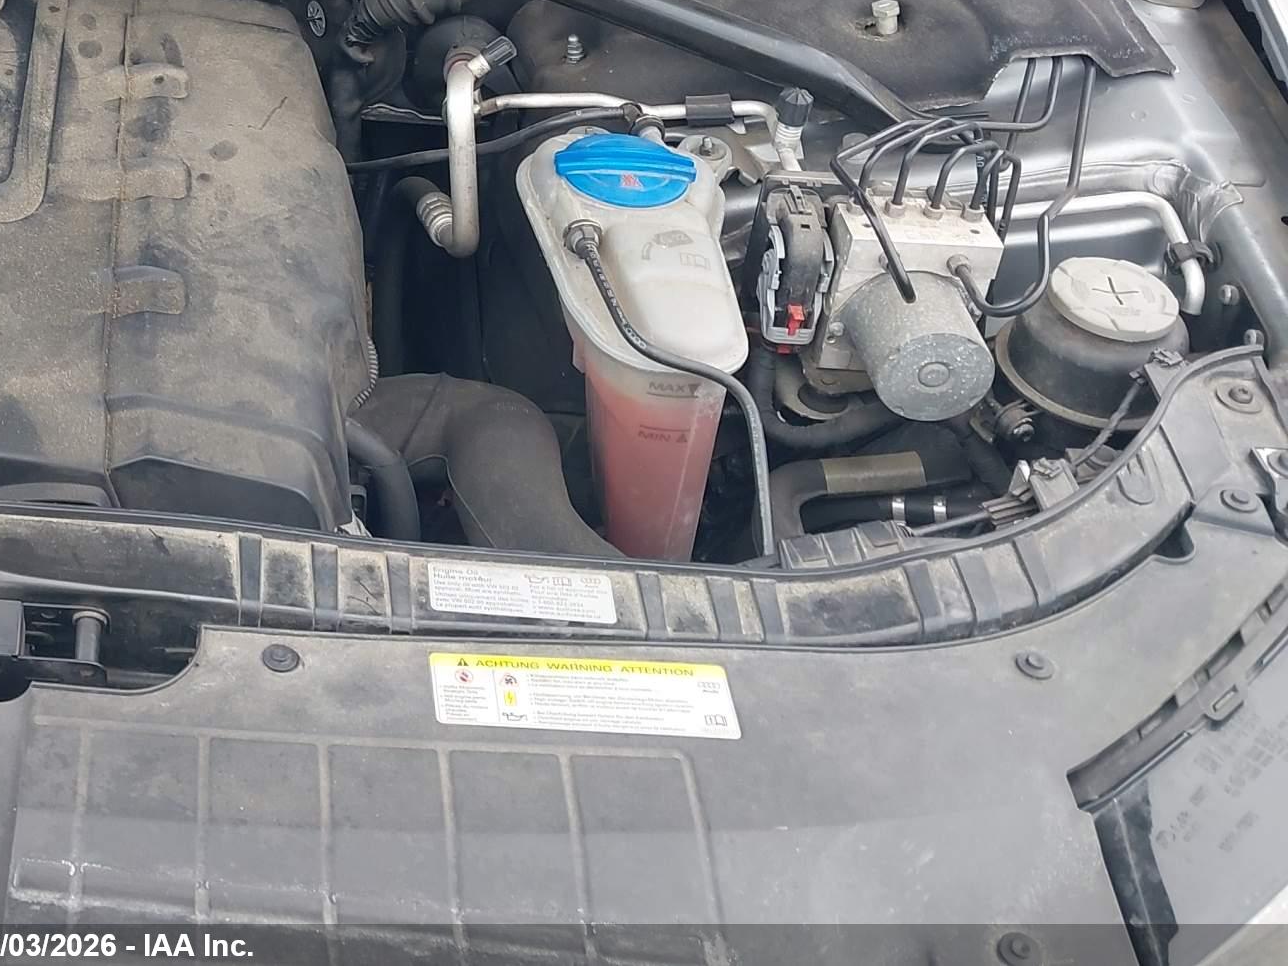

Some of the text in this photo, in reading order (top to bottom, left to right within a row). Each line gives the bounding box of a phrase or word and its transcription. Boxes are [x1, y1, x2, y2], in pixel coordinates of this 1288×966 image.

[648, 381, 686, 393] MAX
[638, 430, 672, 442] MIN
[475, 659, 694, 677] ACHTUNG WARNING ATTENTION
